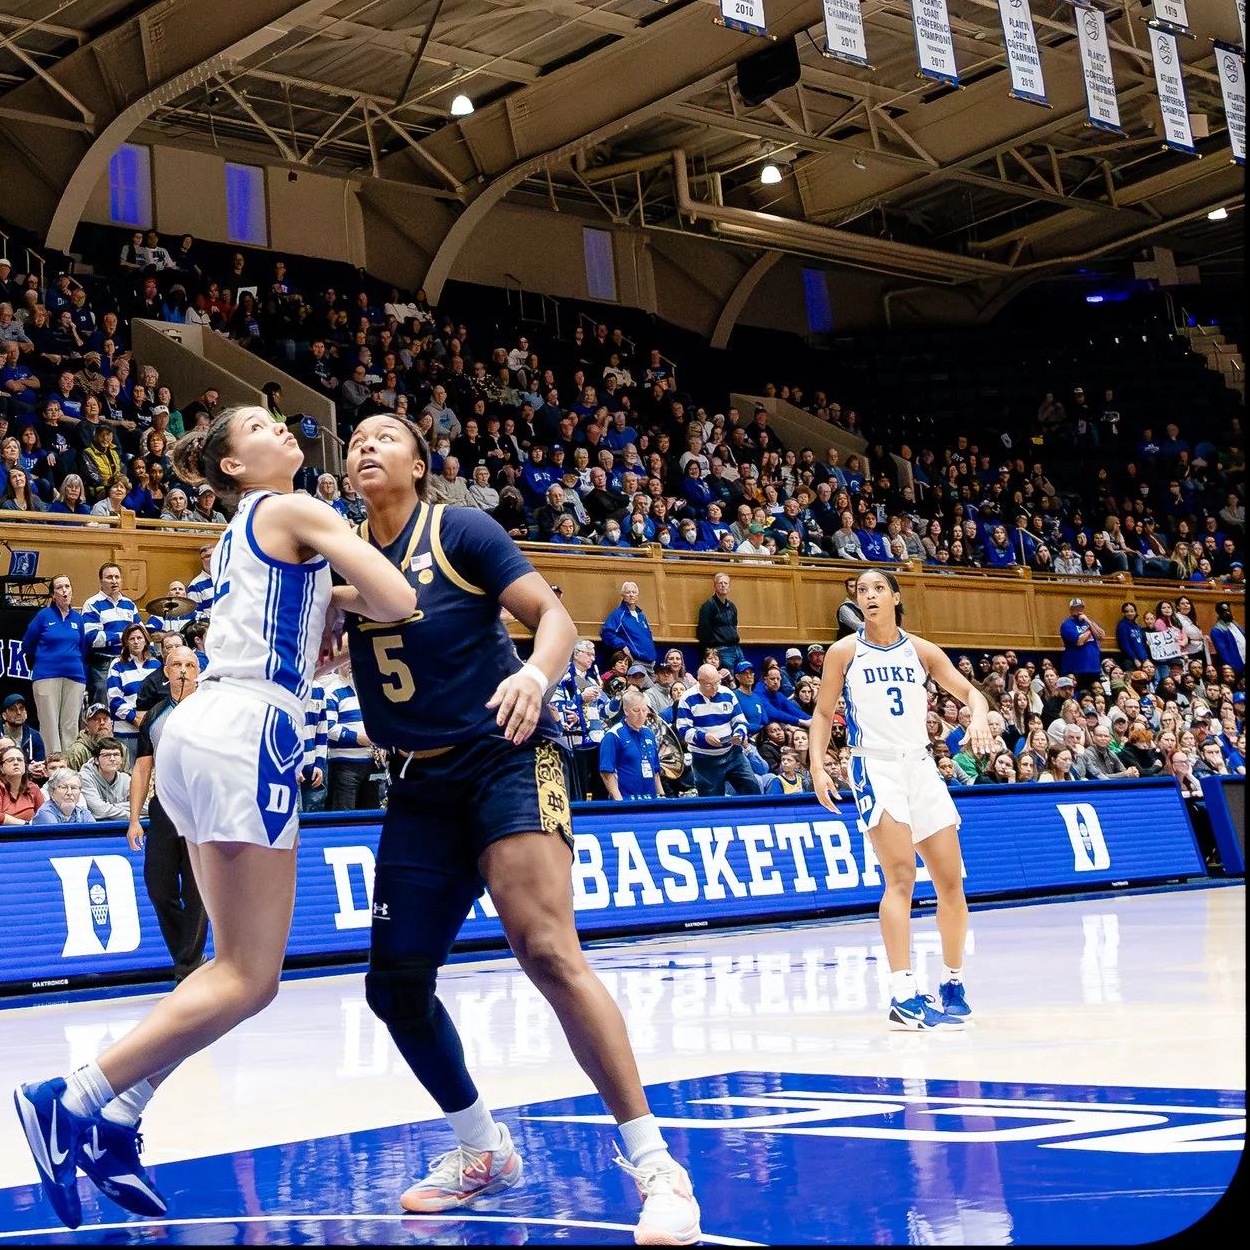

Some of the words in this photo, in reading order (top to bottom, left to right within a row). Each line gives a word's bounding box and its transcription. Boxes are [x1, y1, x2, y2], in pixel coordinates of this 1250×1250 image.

[736, 3, 753, 17] 2010
[828, 7, 861, 25] CHAMPIONS
[924, 7, 939, 20] COAST
[841, 36, 856, 49] 2011
[931, 57, 944, 68] 2017
[372, 635, 416, 703] 5
[863, 667, 916, 684] DUKE
[886, 687, 904, 716] 3
[32, 978, 69, 988] DAKTRONICS
